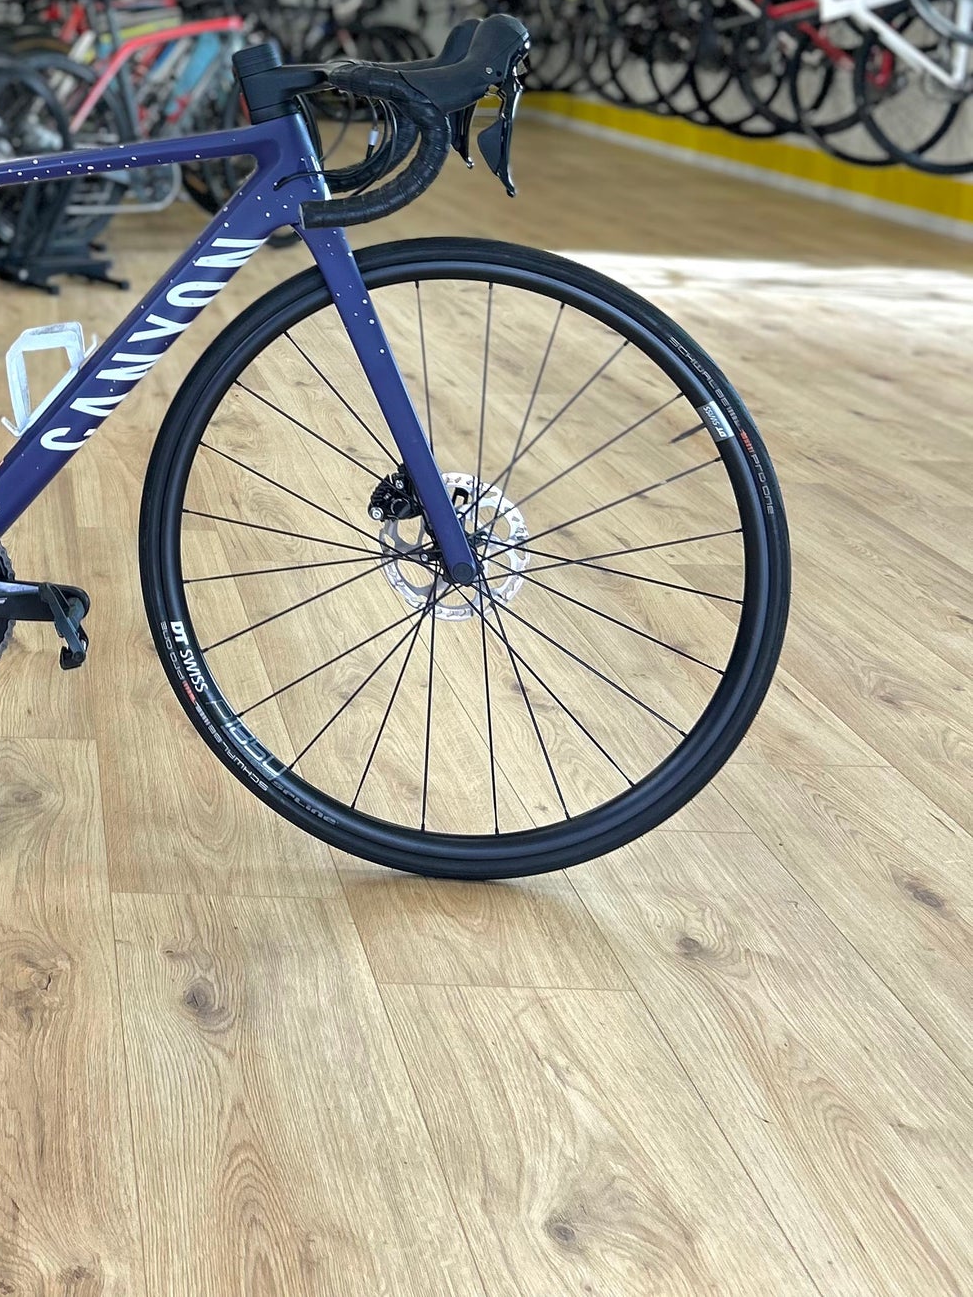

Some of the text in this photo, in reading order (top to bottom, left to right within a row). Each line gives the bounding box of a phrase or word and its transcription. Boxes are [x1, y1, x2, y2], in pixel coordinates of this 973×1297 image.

[40, 238, 268, 451] CANYON
[668, 336, 730, 407] SCHWALBE
[703, 405, 728, 438] DT SWISS
[170, 620, 209, 693] DT SWISS
[207, 724, 269, 792] SCHWALBE
